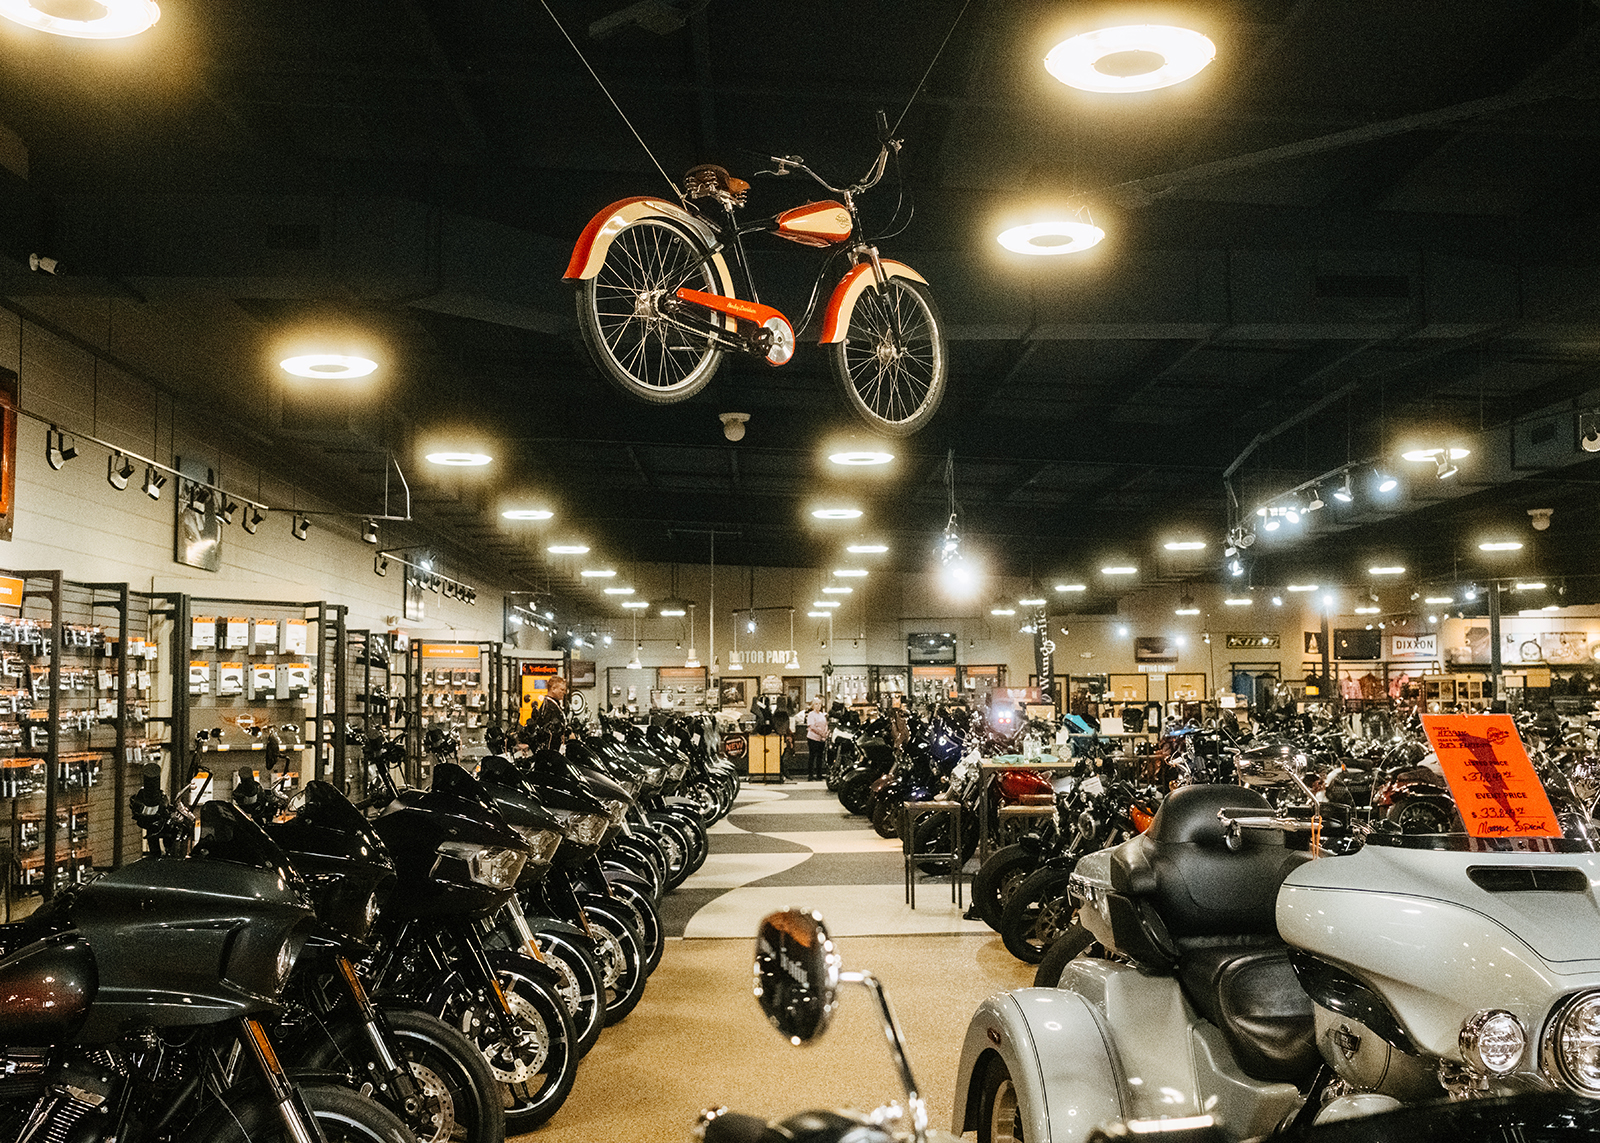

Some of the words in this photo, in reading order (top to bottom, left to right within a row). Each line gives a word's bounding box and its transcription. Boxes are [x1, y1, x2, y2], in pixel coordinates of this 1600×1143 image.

[1396, 640, 1434, 650] DIXXON
[729, 650, 765, 664] OTOR
[726, 740, 743, 751] NEW
[1475, 792, 1501, 800] EVENT
